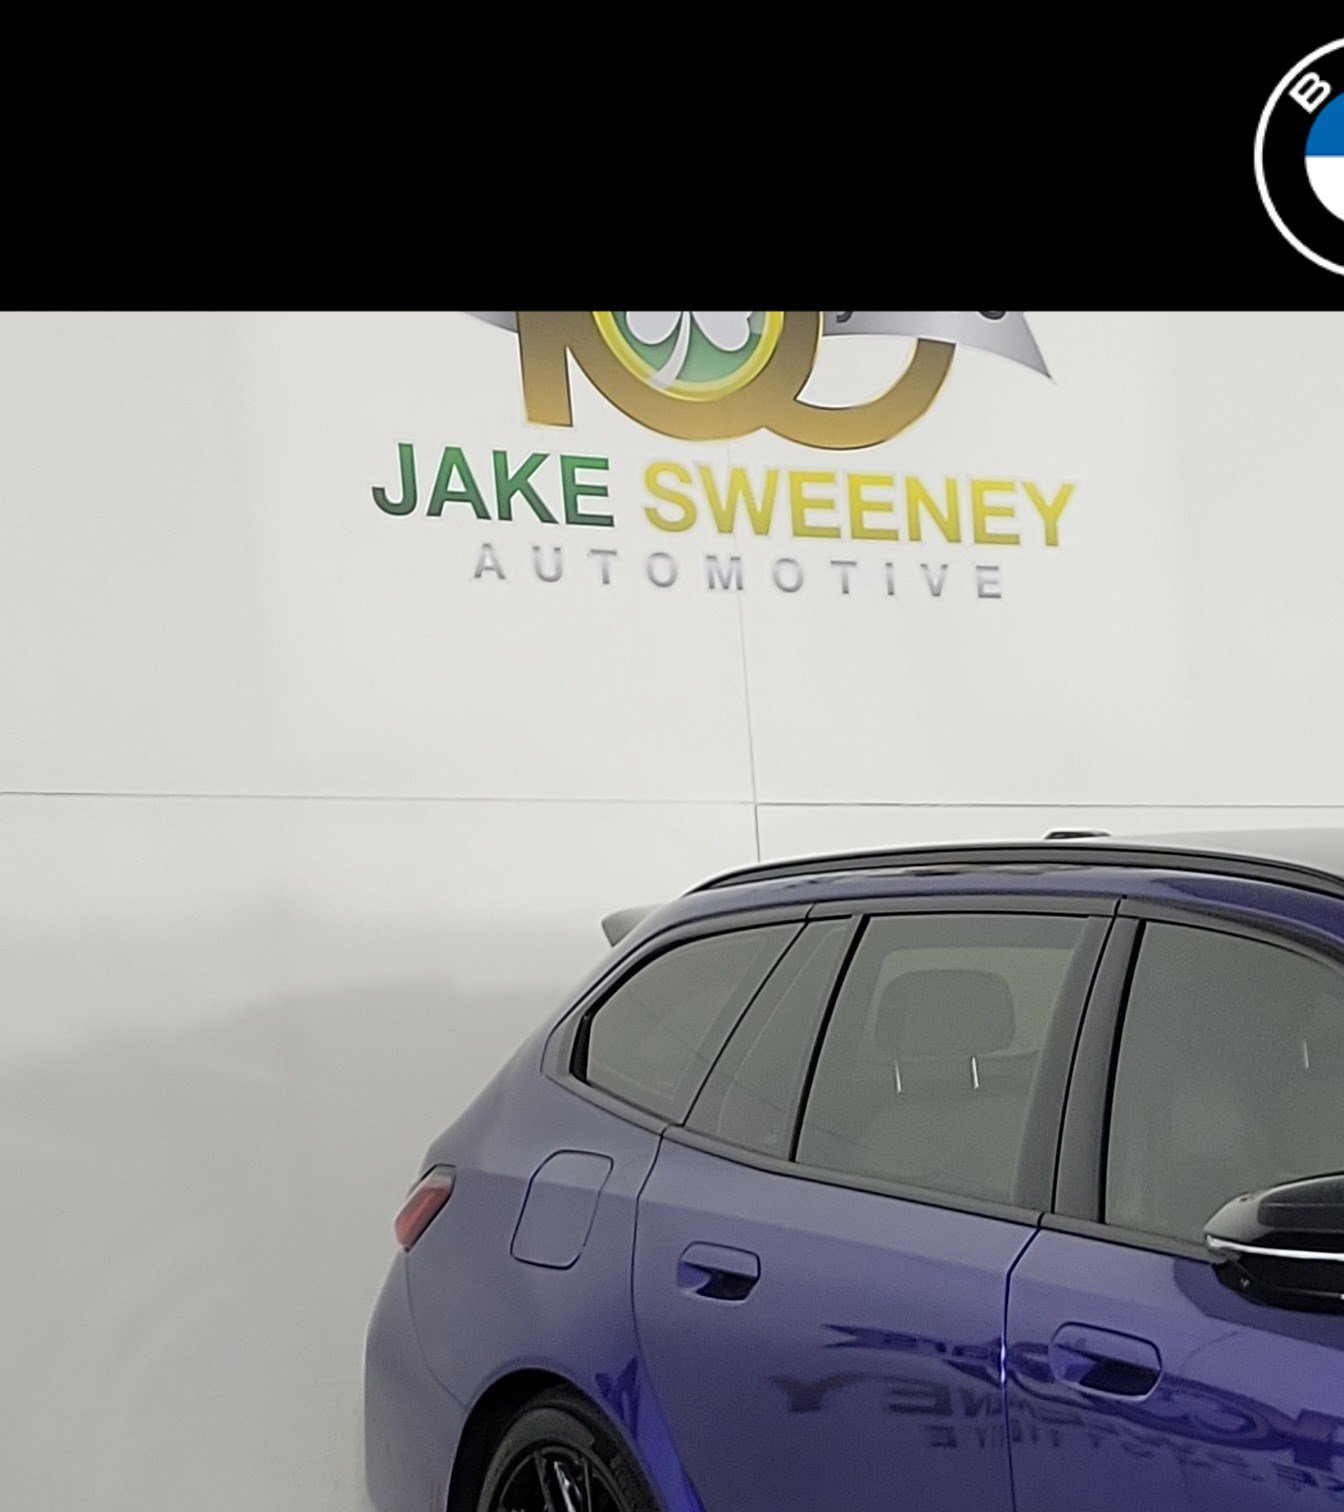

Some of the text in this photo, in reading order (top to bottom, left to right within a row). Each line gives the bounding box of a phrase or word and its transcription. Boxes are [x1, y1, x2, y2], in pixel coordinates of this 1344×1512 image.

[372, 443, 1075, 546] JAKE SWEENEY
[474, 543, 1003, 599] AUTOMOTIVE
